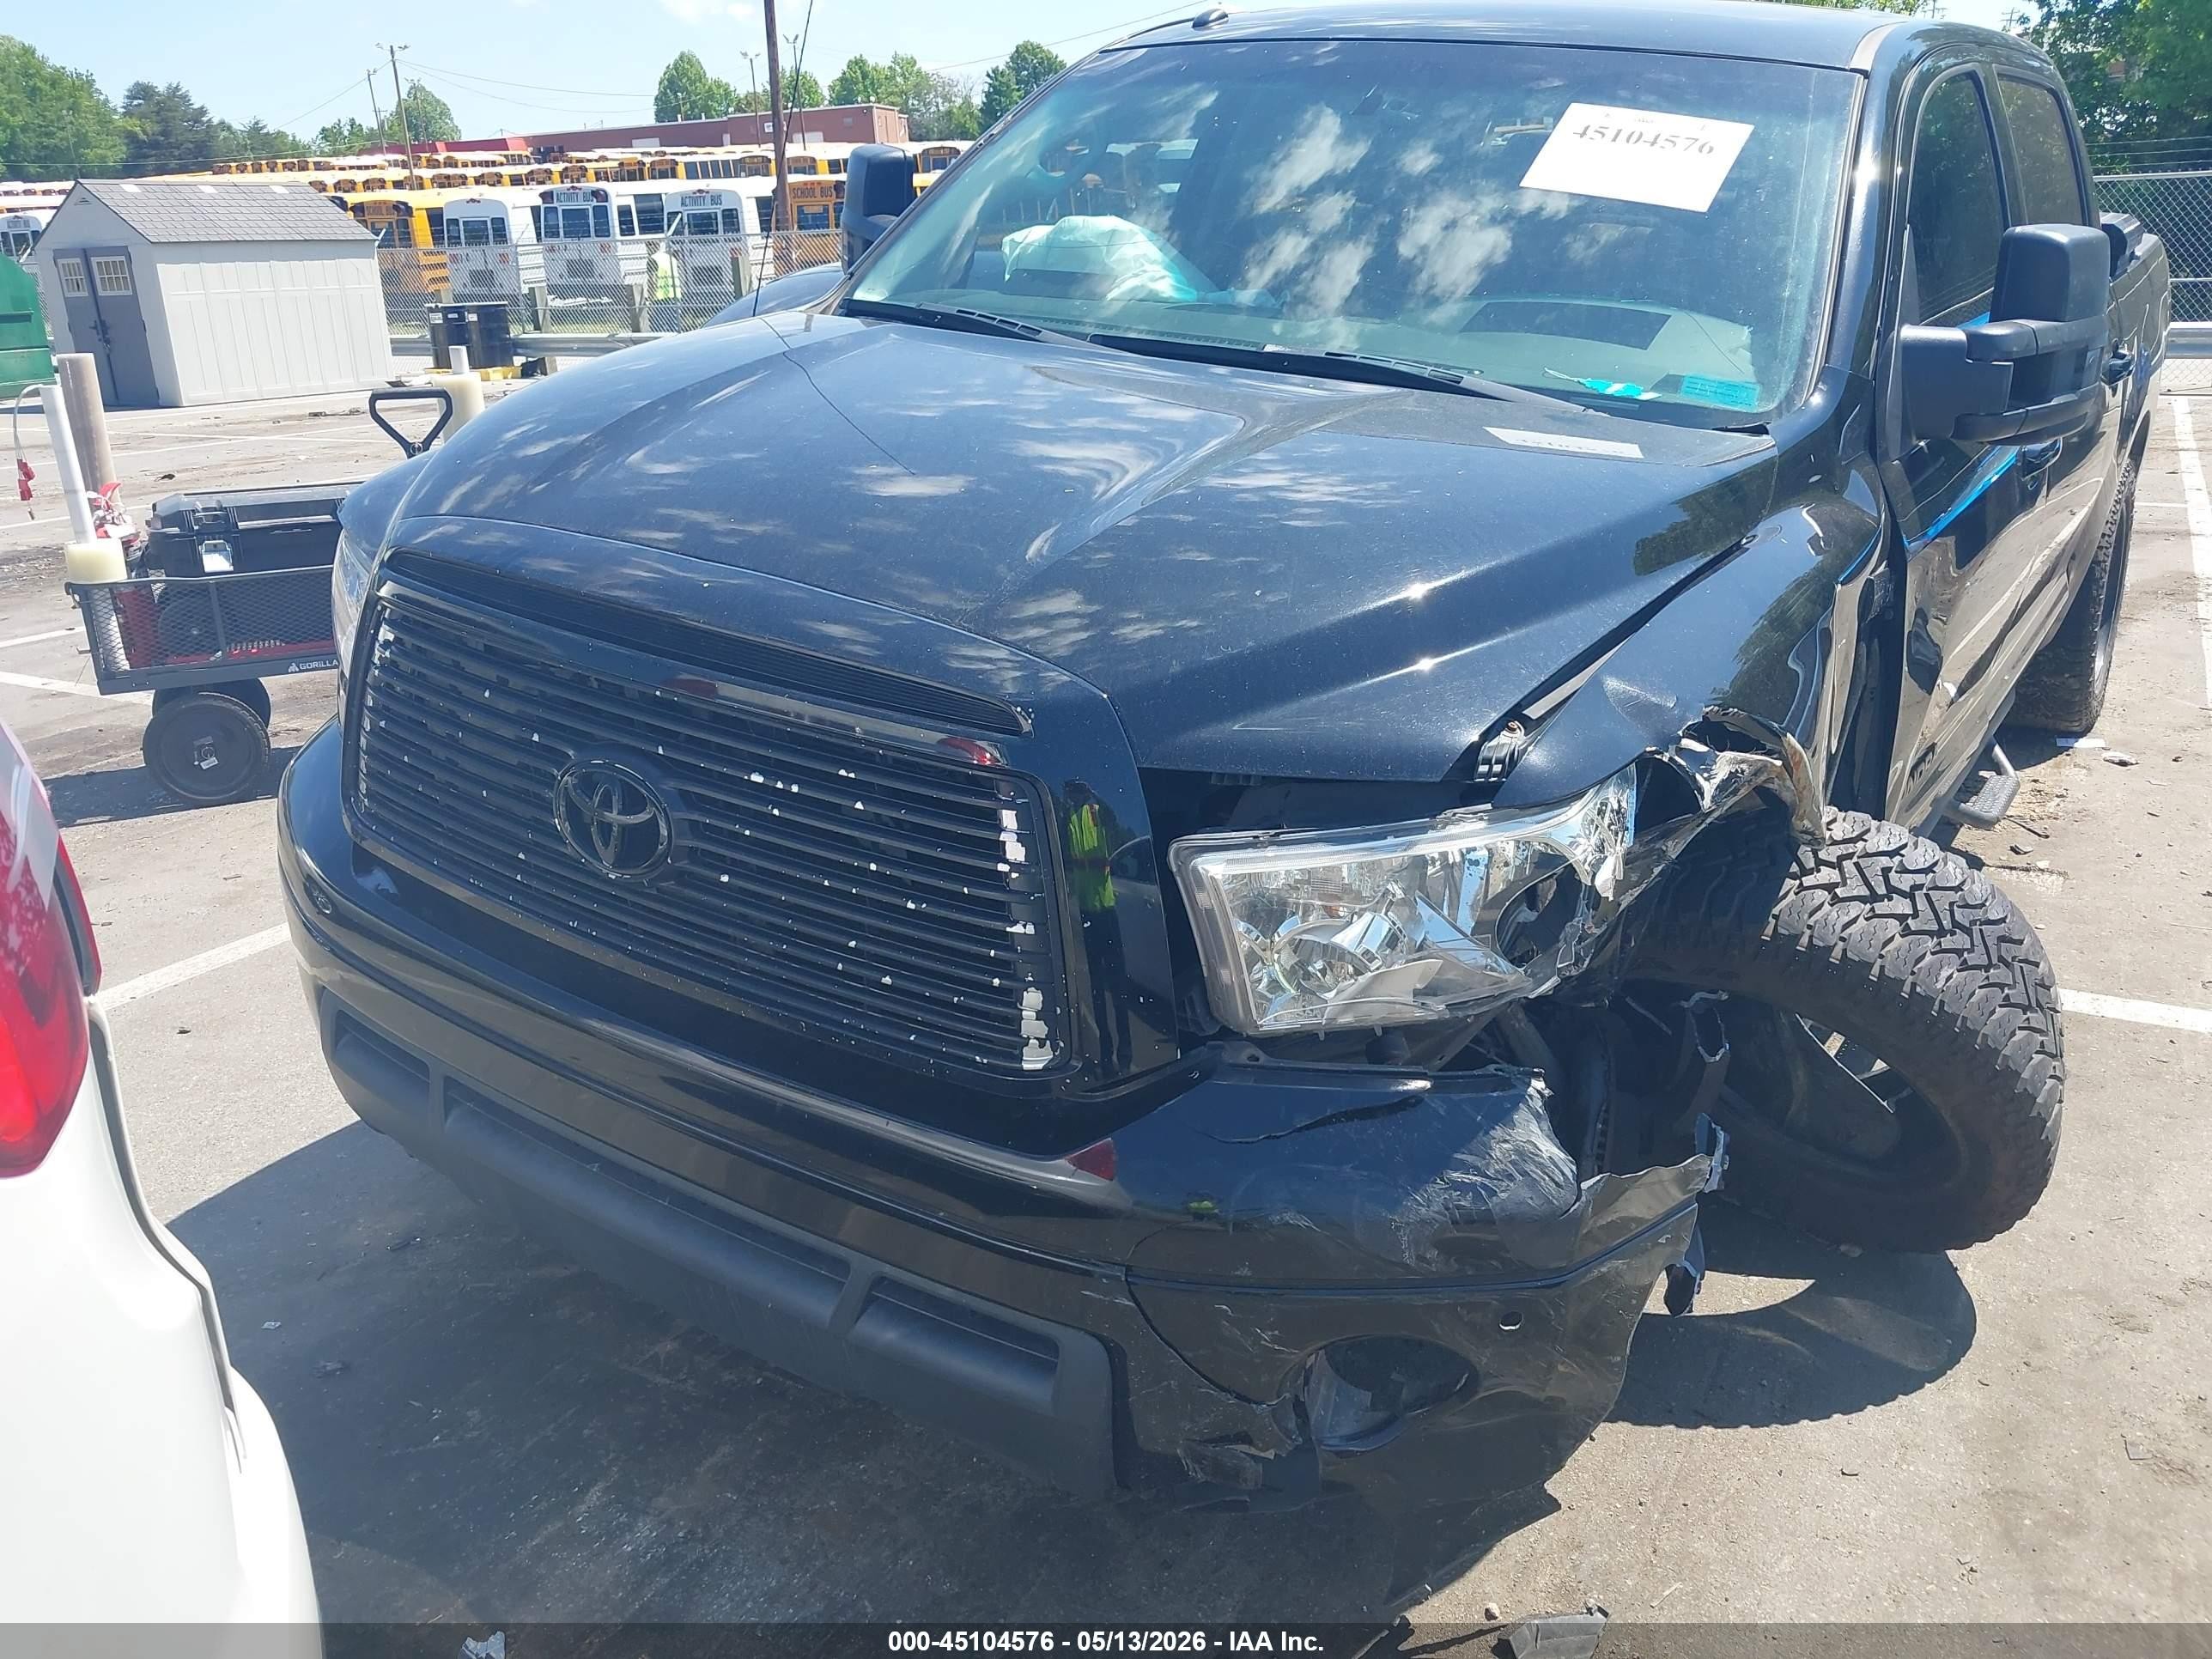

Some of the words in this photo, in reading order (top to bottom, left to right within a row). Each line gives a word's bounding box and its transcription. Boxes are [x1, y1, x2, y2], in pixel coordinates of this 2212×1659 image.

[1572, 125, 1715, 155] 45104576
[556, 191, 579, 204] ACTIVITY
[792, 186, 817, 199] SCHOOL
[820, 185, 833, 198] BUS
[681, 195, 706, 207] ACTIVITY
[710, 194, 723, 206] BUS
[300, 659, 338, 670] GORILLA
